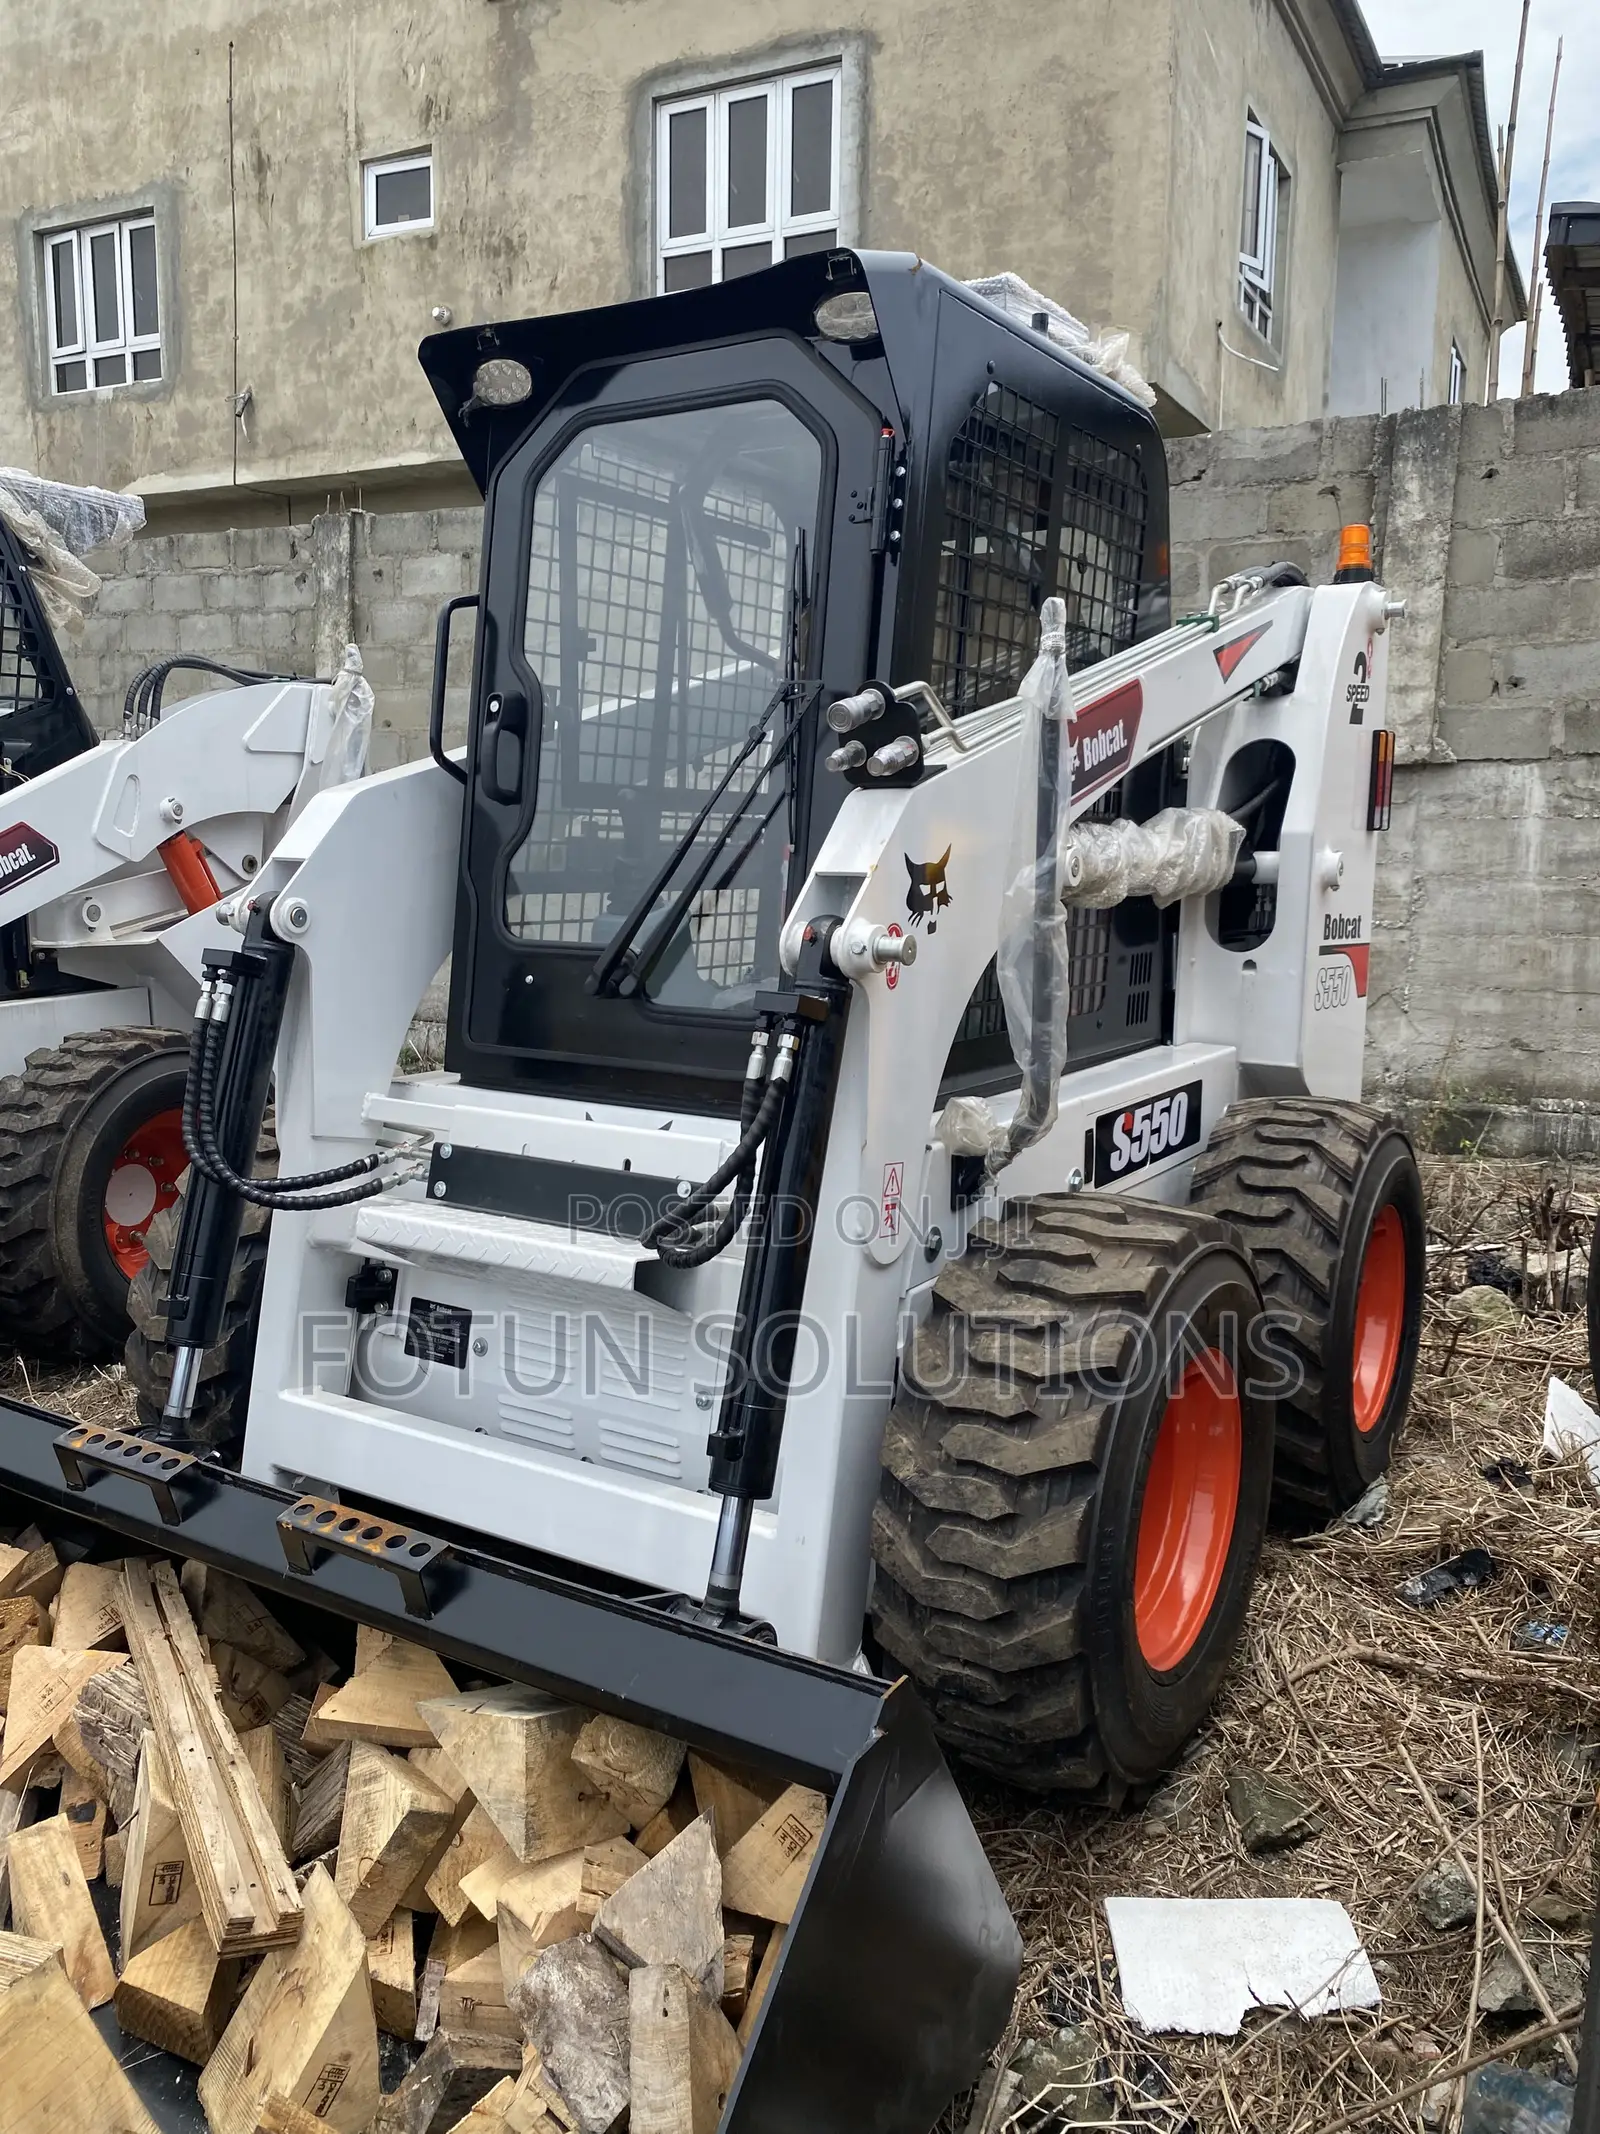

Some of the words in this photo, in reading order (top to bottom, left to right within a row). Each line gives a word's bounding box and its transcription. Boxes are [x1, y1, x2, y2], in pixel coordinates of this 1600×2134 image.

[1346, 684, 1370, 703] SPEED
[1323, 913, 1362, 941] Bobcat
[1314, 964, 1351, 1012] S550
[1110, 1091, 1188, 1172] S550
